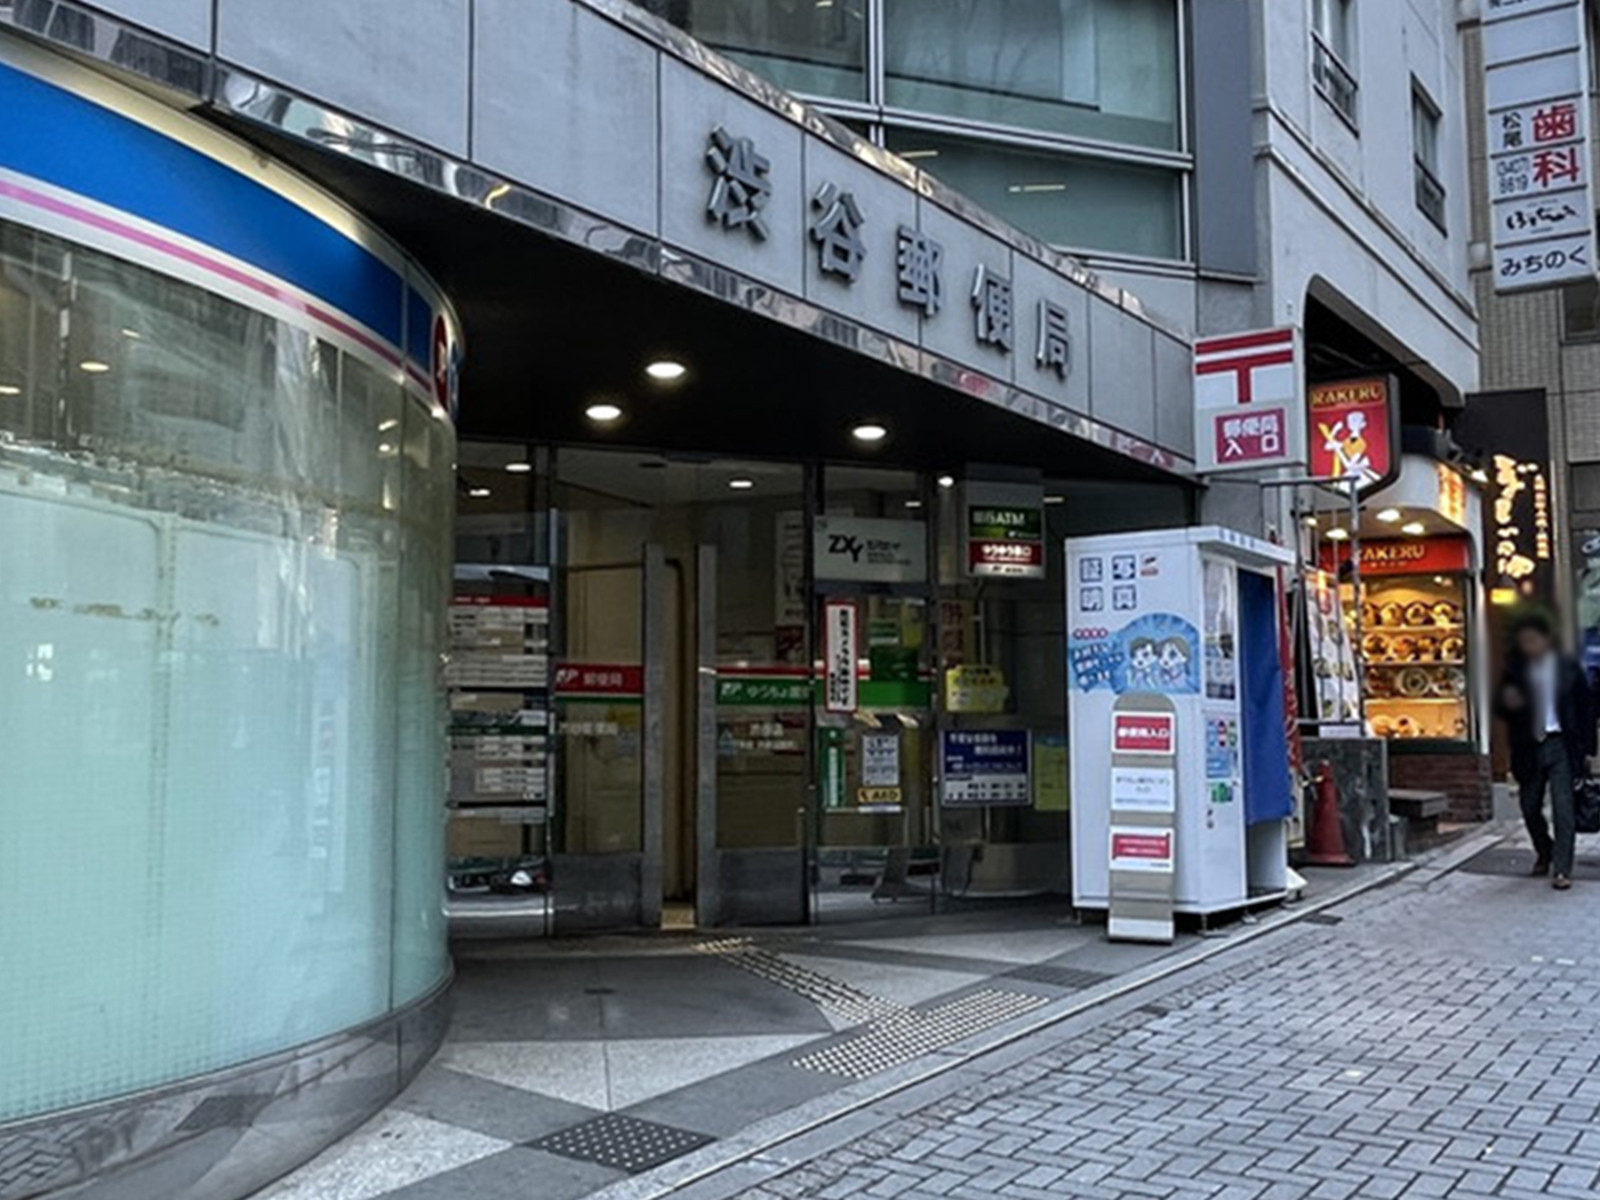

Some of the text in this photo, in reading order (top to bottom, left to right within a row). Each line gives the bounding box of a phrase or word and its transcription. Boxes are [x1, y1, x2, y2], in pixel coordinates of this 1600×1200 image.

[1532, 103, 1580, 187] 歯科
[704, 121, 1071, 382] 渋谷郵便局
[1500, 246, 1587, 277] みちのく
[1312, 385, 1381, 405] RAKERU
[1223, 414, 1279, 437] 郵便局
